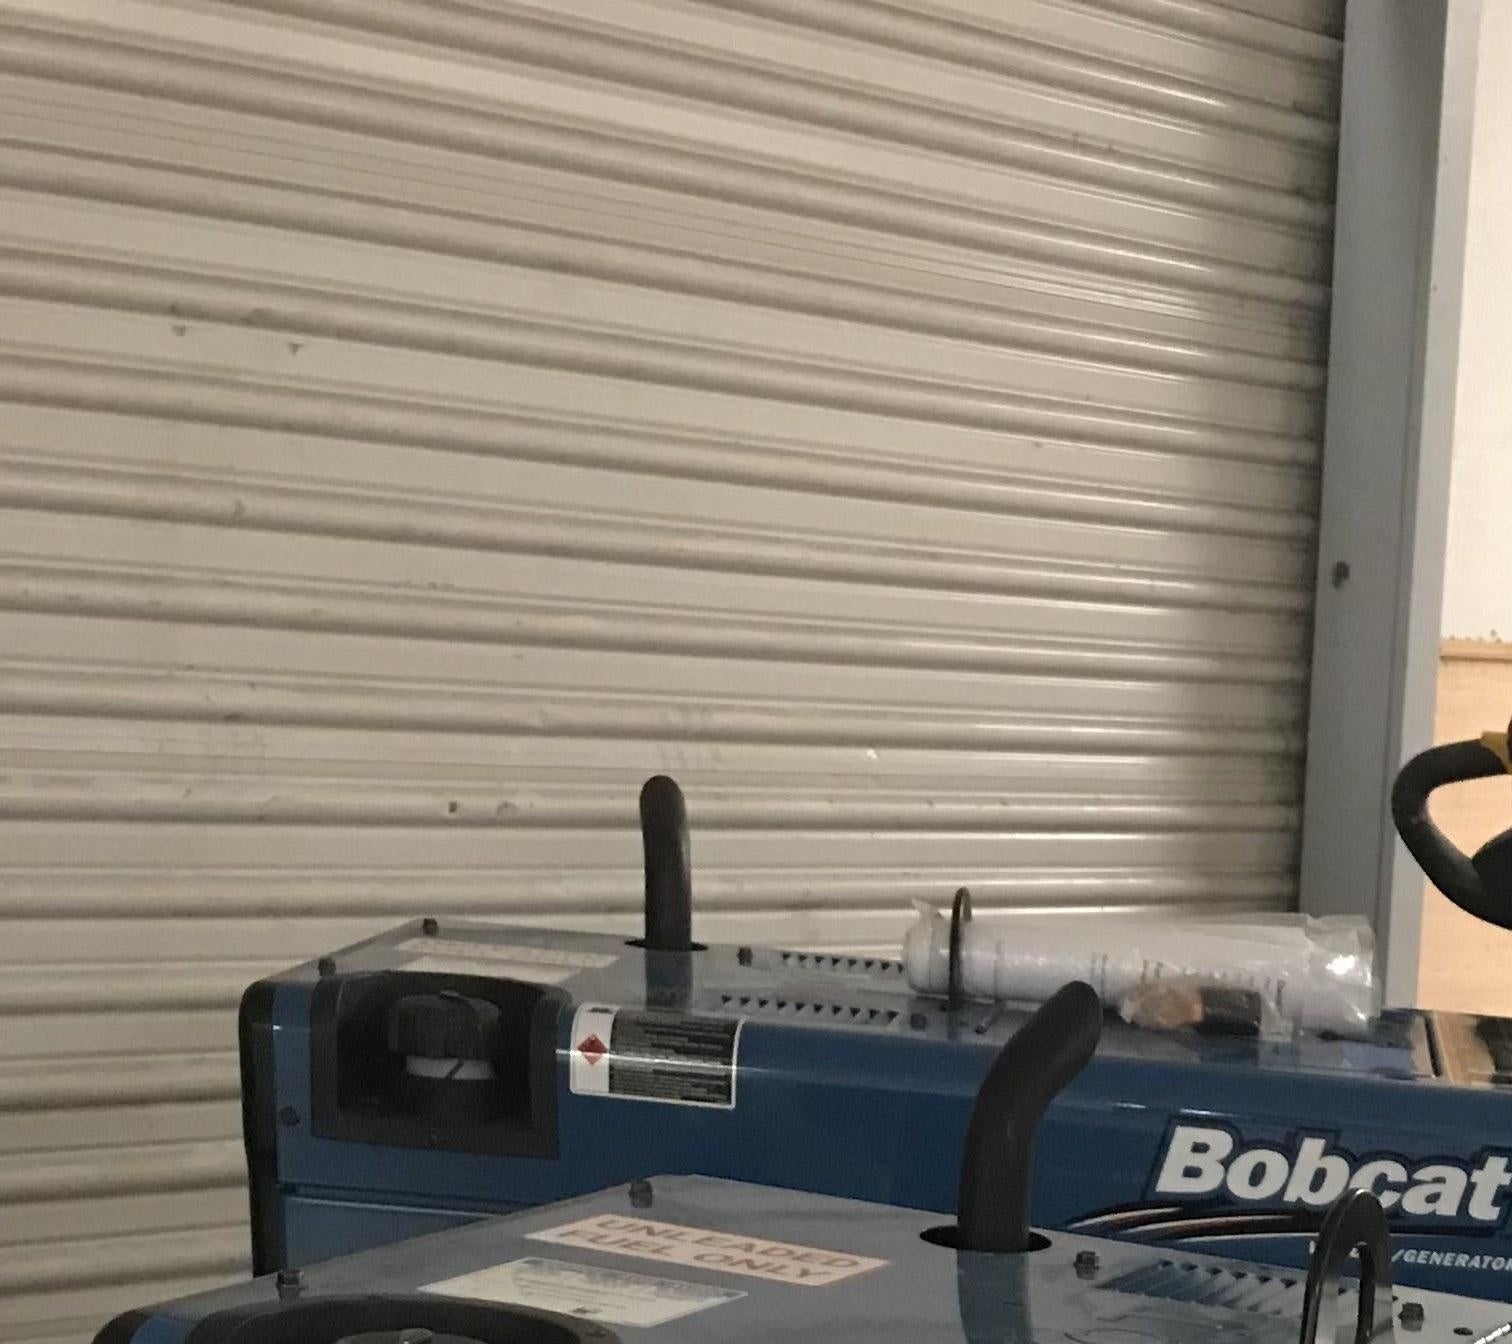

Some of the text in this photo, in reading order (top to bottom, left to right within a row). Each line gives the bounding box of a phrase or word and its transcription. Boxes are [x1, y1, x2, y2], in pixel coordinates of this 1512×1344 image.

[1154, 1124, 1512, 1222] Bobcat
[559, 1230, 830, 1281] FUEL ONLY
[598, 1219, 860, 1270] UNLEADED
